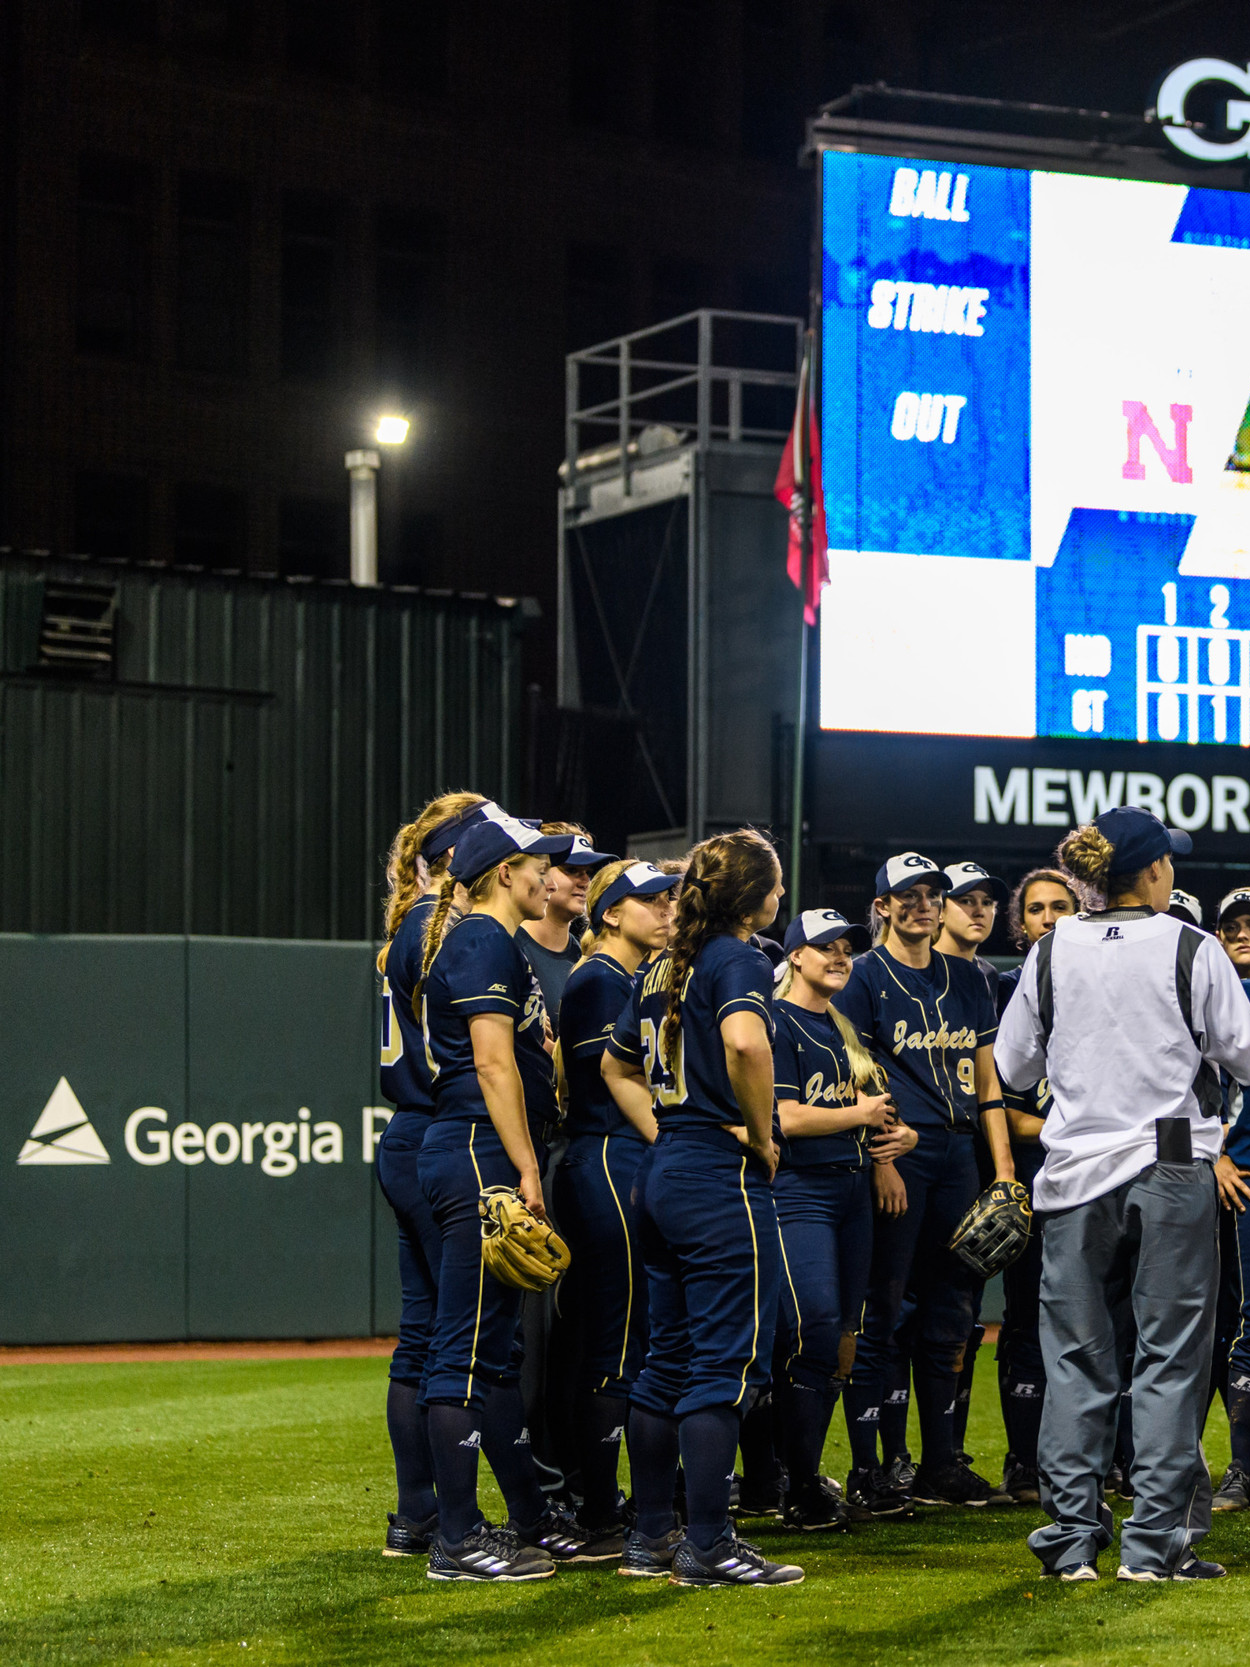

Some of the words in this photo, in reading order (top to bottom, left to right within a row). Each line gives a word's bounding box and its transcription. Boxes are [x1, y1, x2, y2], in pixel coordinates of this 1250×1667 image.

[889, 167, 970, 222] BALL
[868, 279, 989, 337] STRIKE
[891, 391, 967, 444] OUT
[1122, 400, 1193, 484] N
[1162, 582, 1177, 626] 1
[1210, 584, 1230, 629] 2
[1211, 695, 1227, 743] 1
[904, 856, 933, 869] GT
[487, 983, 508, 993] ACC
[892, 1020, 978, 1056] Jackets
[956, 1058, 977, 1095] 9
[124, 1106, 343, 1177] Georgia
